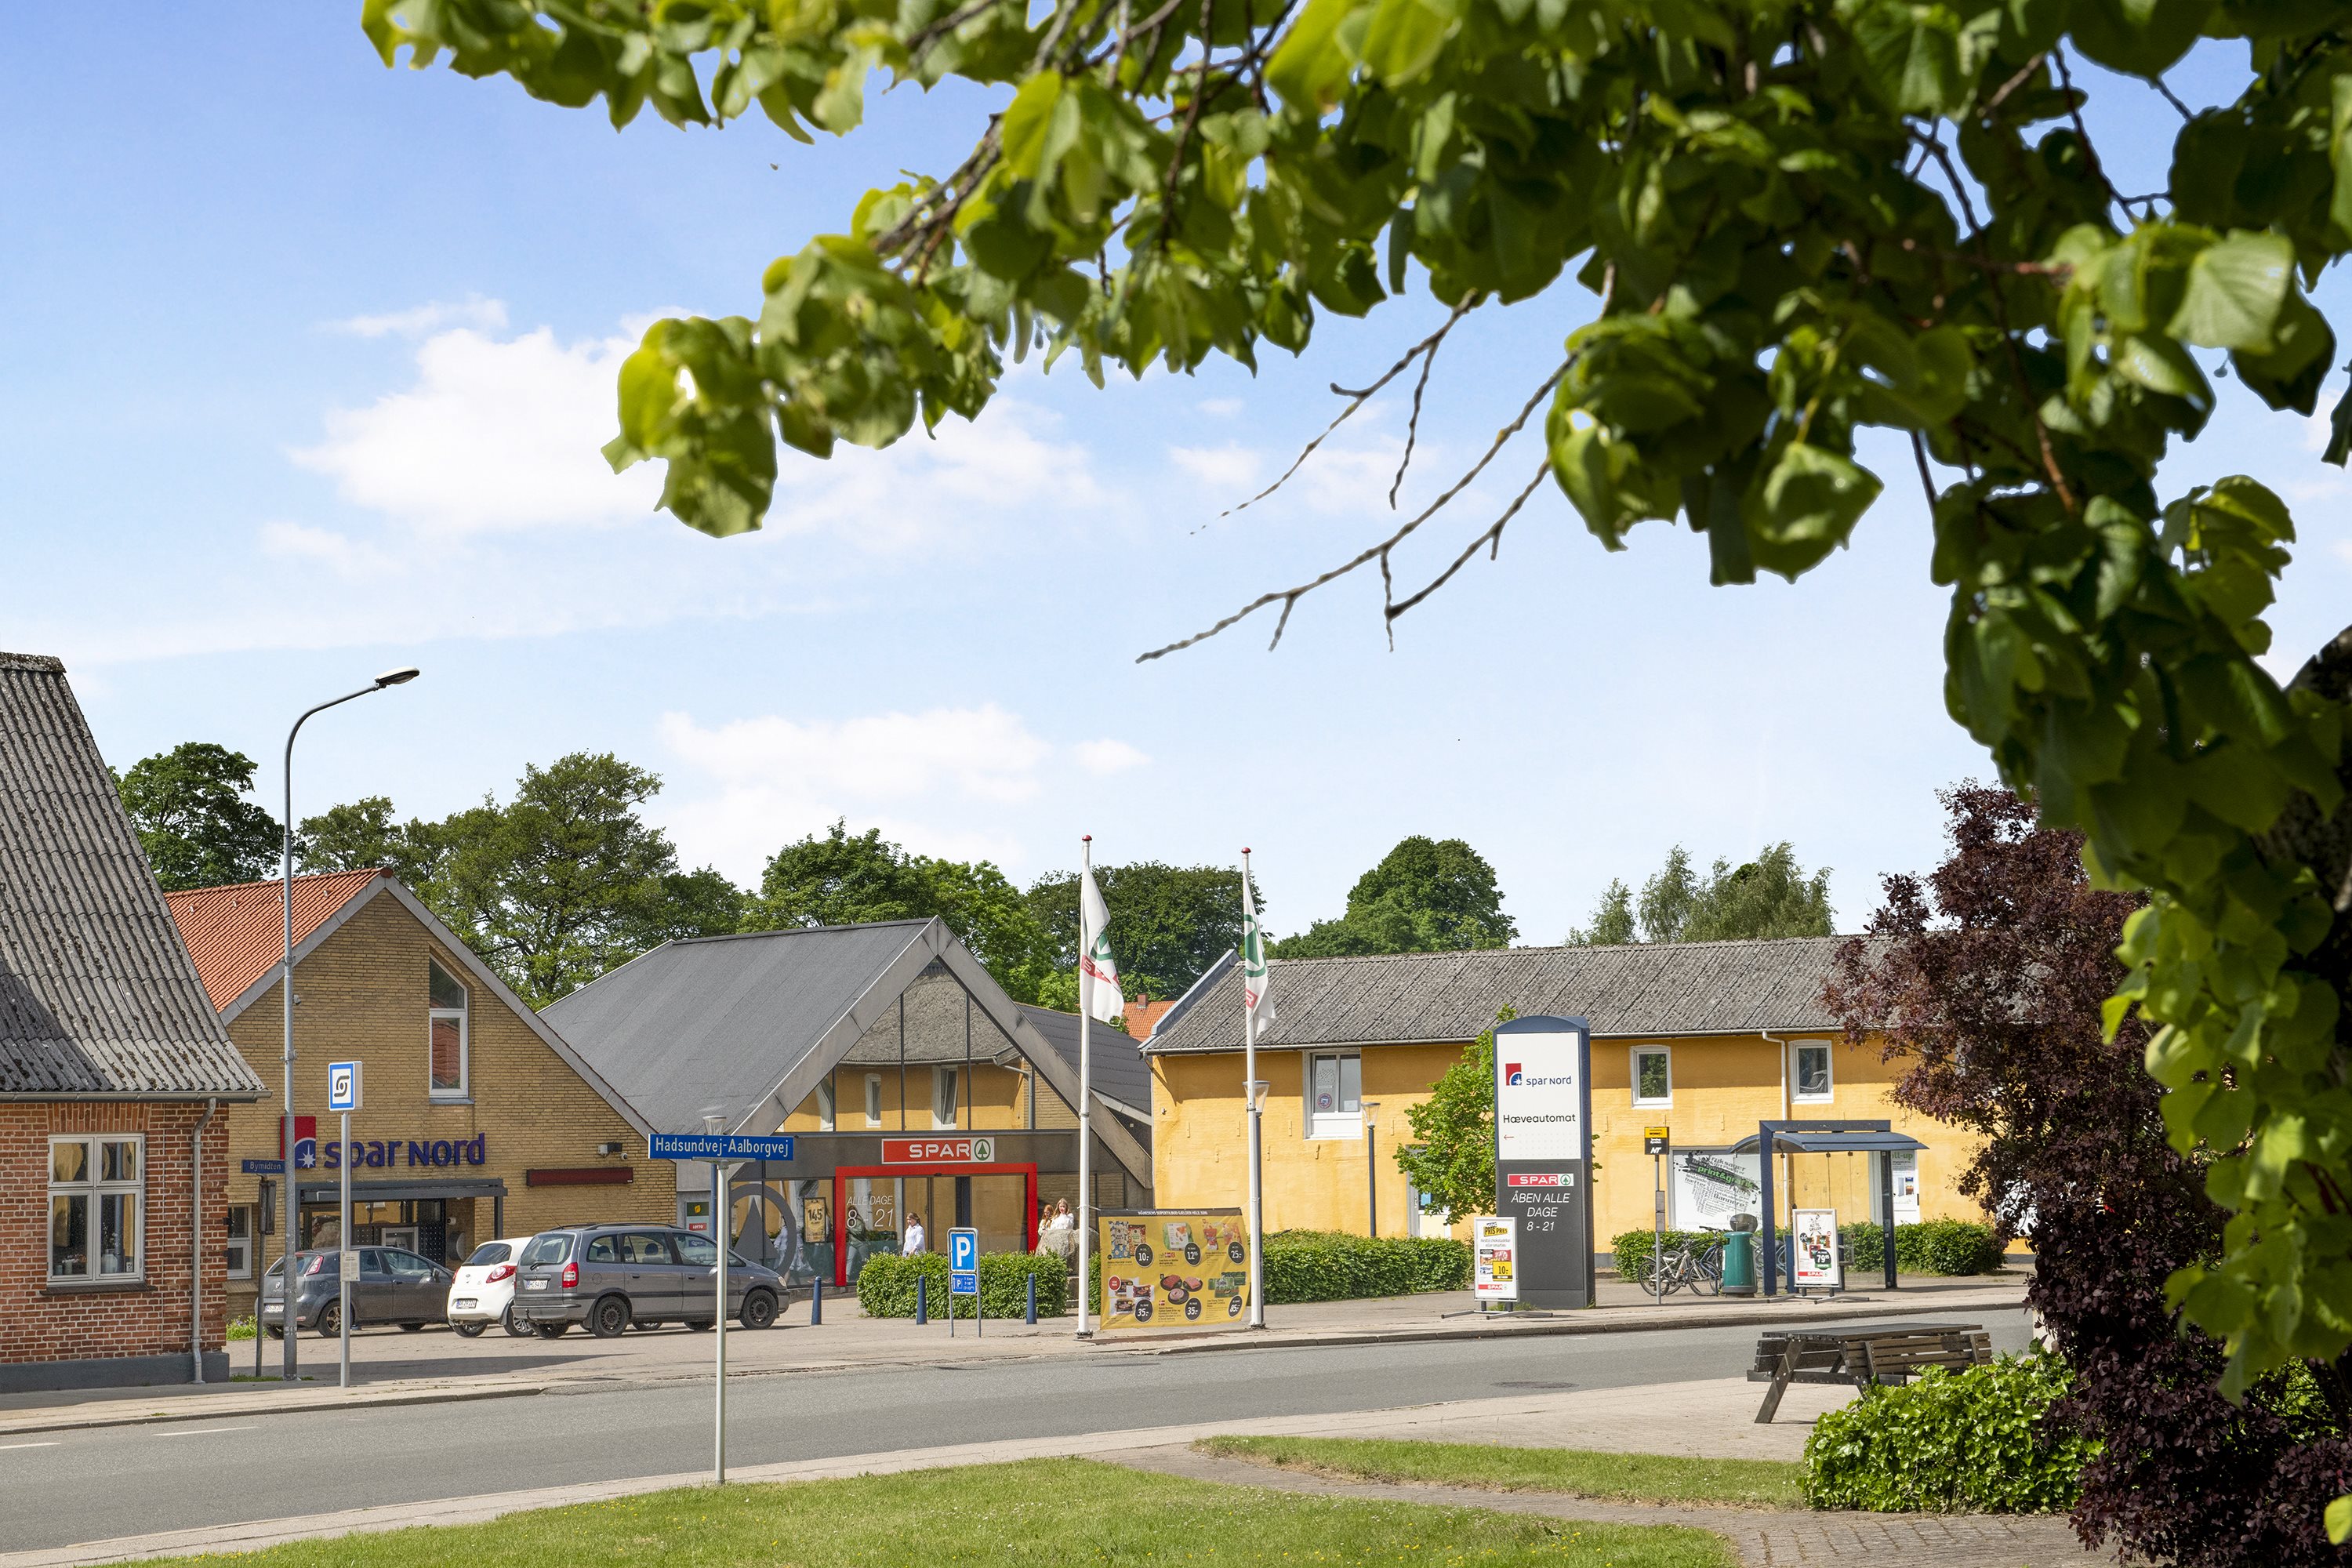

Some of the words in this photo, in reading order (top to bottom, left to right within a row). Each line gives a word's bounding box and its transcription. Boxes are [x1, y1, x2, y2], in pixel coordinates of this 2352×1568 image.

[1526, 1077, 1547, 1087] spar
[1503, 1114, 1576, 1123] Hæveautomat
[655, 1137, 789, 1158] Hadsundvej-Aalborgvej
[909, 1143, 970, 1158] SPAR
[249, 1161, 281, 1171] Bymidten
[1519, 1176, 1558, 1185] SPAR
[847, 1196, 869, 1206] ALLE
[869, 1195, 894, 1206] DAGE
[1511, 1190, 1541, 1203] ÅBEN
[1542, 1193, 1570, 1203] ALLE
[808, 1208, 822, 1221] 145
[1526, 1207, 1559, 1217] DAGE
[848, 1209, 858, 1228] 8
[874, 1208, 894, 1228] 21
[1526, 1221, 1534, 1231] 8
[1542, 1221, 1555, 1231] 21
[956, 1236, 971, 1267] P
